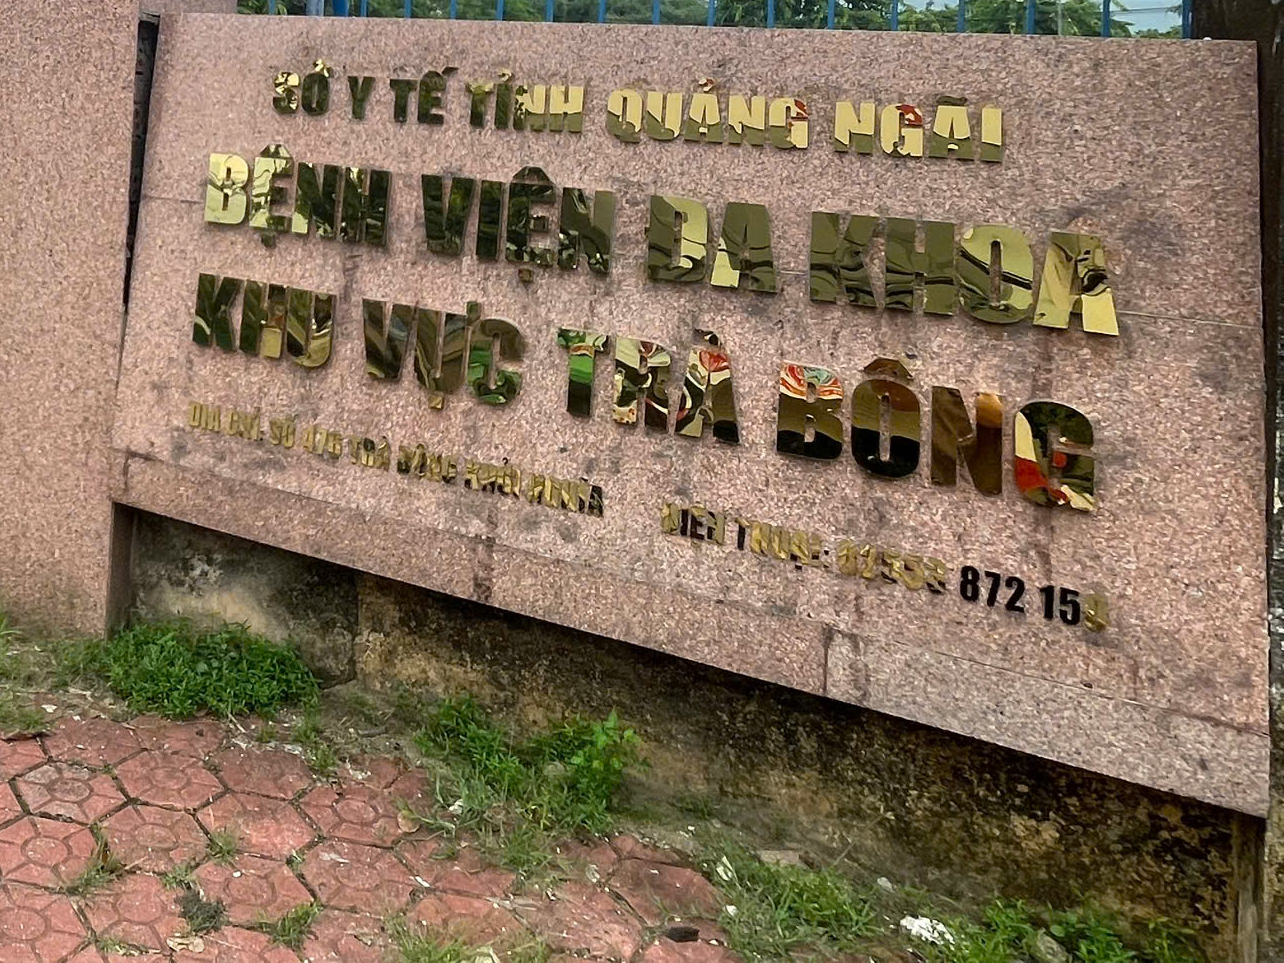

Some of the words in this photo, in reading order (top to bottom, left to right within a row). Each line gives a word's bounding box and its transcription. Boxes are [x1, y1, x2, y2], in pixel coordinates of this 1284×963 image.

[273, 60, 330, 116] SỞ
[347, 76, 376, 120] Y
[389, 66, 457, 125] TẾ
[465, 69, 584, 133] TỈNH
[606, 78, 808, 149] QUẢNG
[833, 94, 1005, 163] NGÃI
[204, 144, 392, 250] BỆNH
[421, 167, 617, 284] VIỆN
[808, 210, 1120, 336] KHOA
[193, 272, 339, 369] KHU
[363, 299, 526, 411] VỰC
[557, 327, 742, 445] TRÀ
[959, 565, 1026, 614] 872
